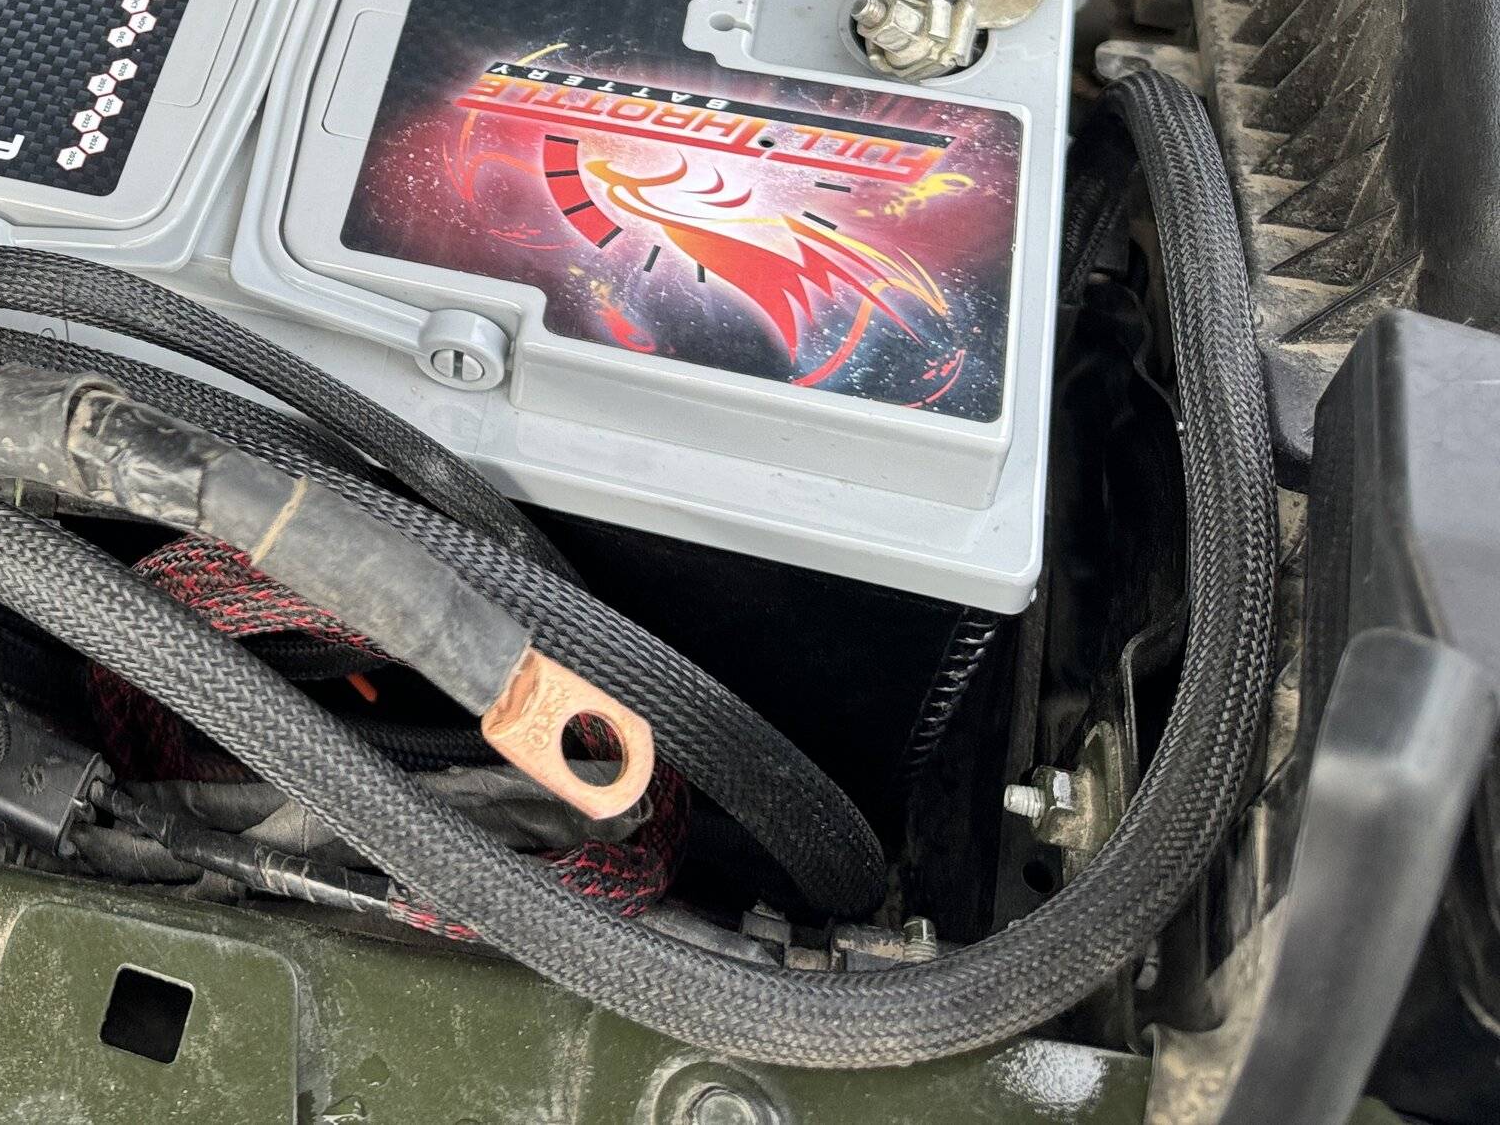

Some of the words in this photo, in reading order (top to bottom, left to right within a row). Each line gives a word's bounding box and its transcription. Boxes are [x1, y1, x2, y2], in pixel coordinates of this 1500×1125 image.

[490, 62, 730, 110] BATTERY
[457, 74, 772, 158] THROTTLE
[768, 124, 947, 183] FULL
